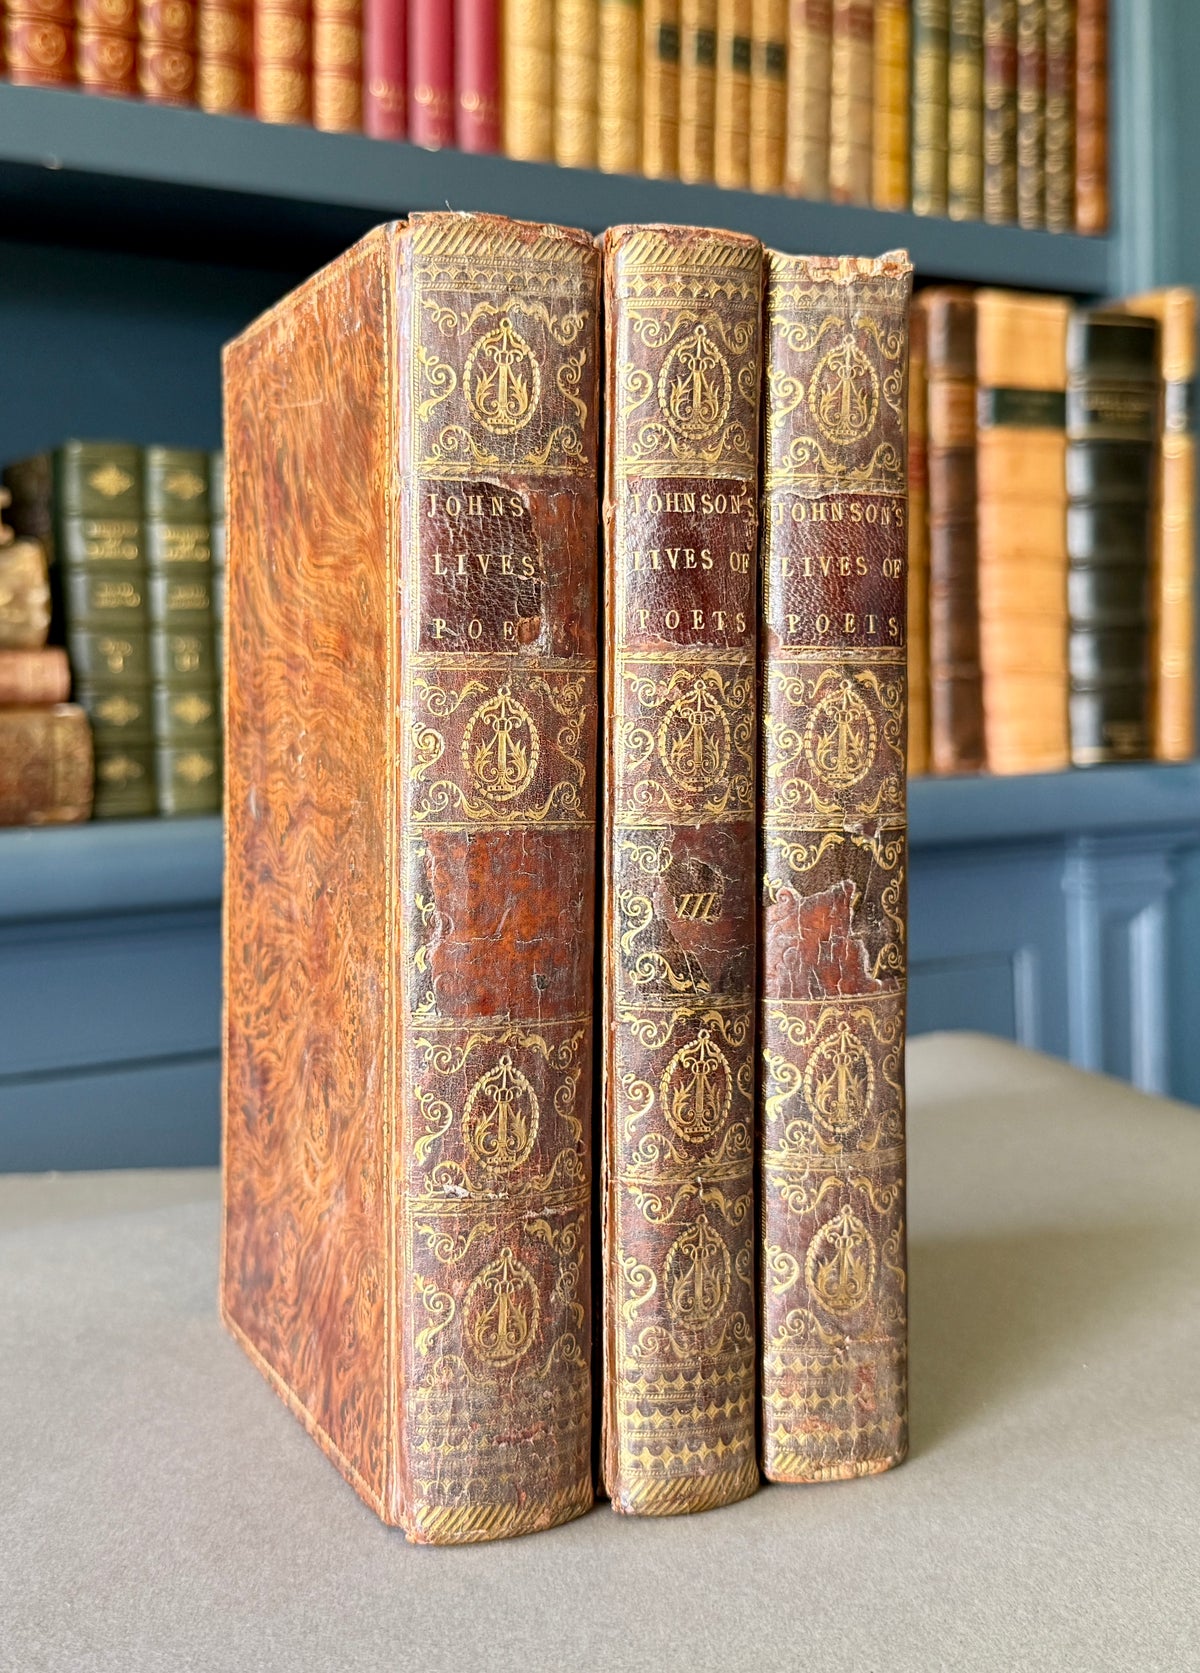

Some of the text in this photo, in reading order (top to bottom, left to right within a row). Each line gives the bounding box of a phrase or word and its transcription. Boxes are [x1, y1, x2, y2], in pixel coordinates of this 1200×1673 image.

[427, 493, 524, 518] JOHNS
[772, 500, 904, 528] JOHNSON'S
[432, 553, 535, 577] LIVES
[632, 547, 750, 574] LIVES OF
[780, 556, 902, 579] LIVES OF
[636, 609, 746, 633] POETS
[785, 613, 898, 637] POETS
